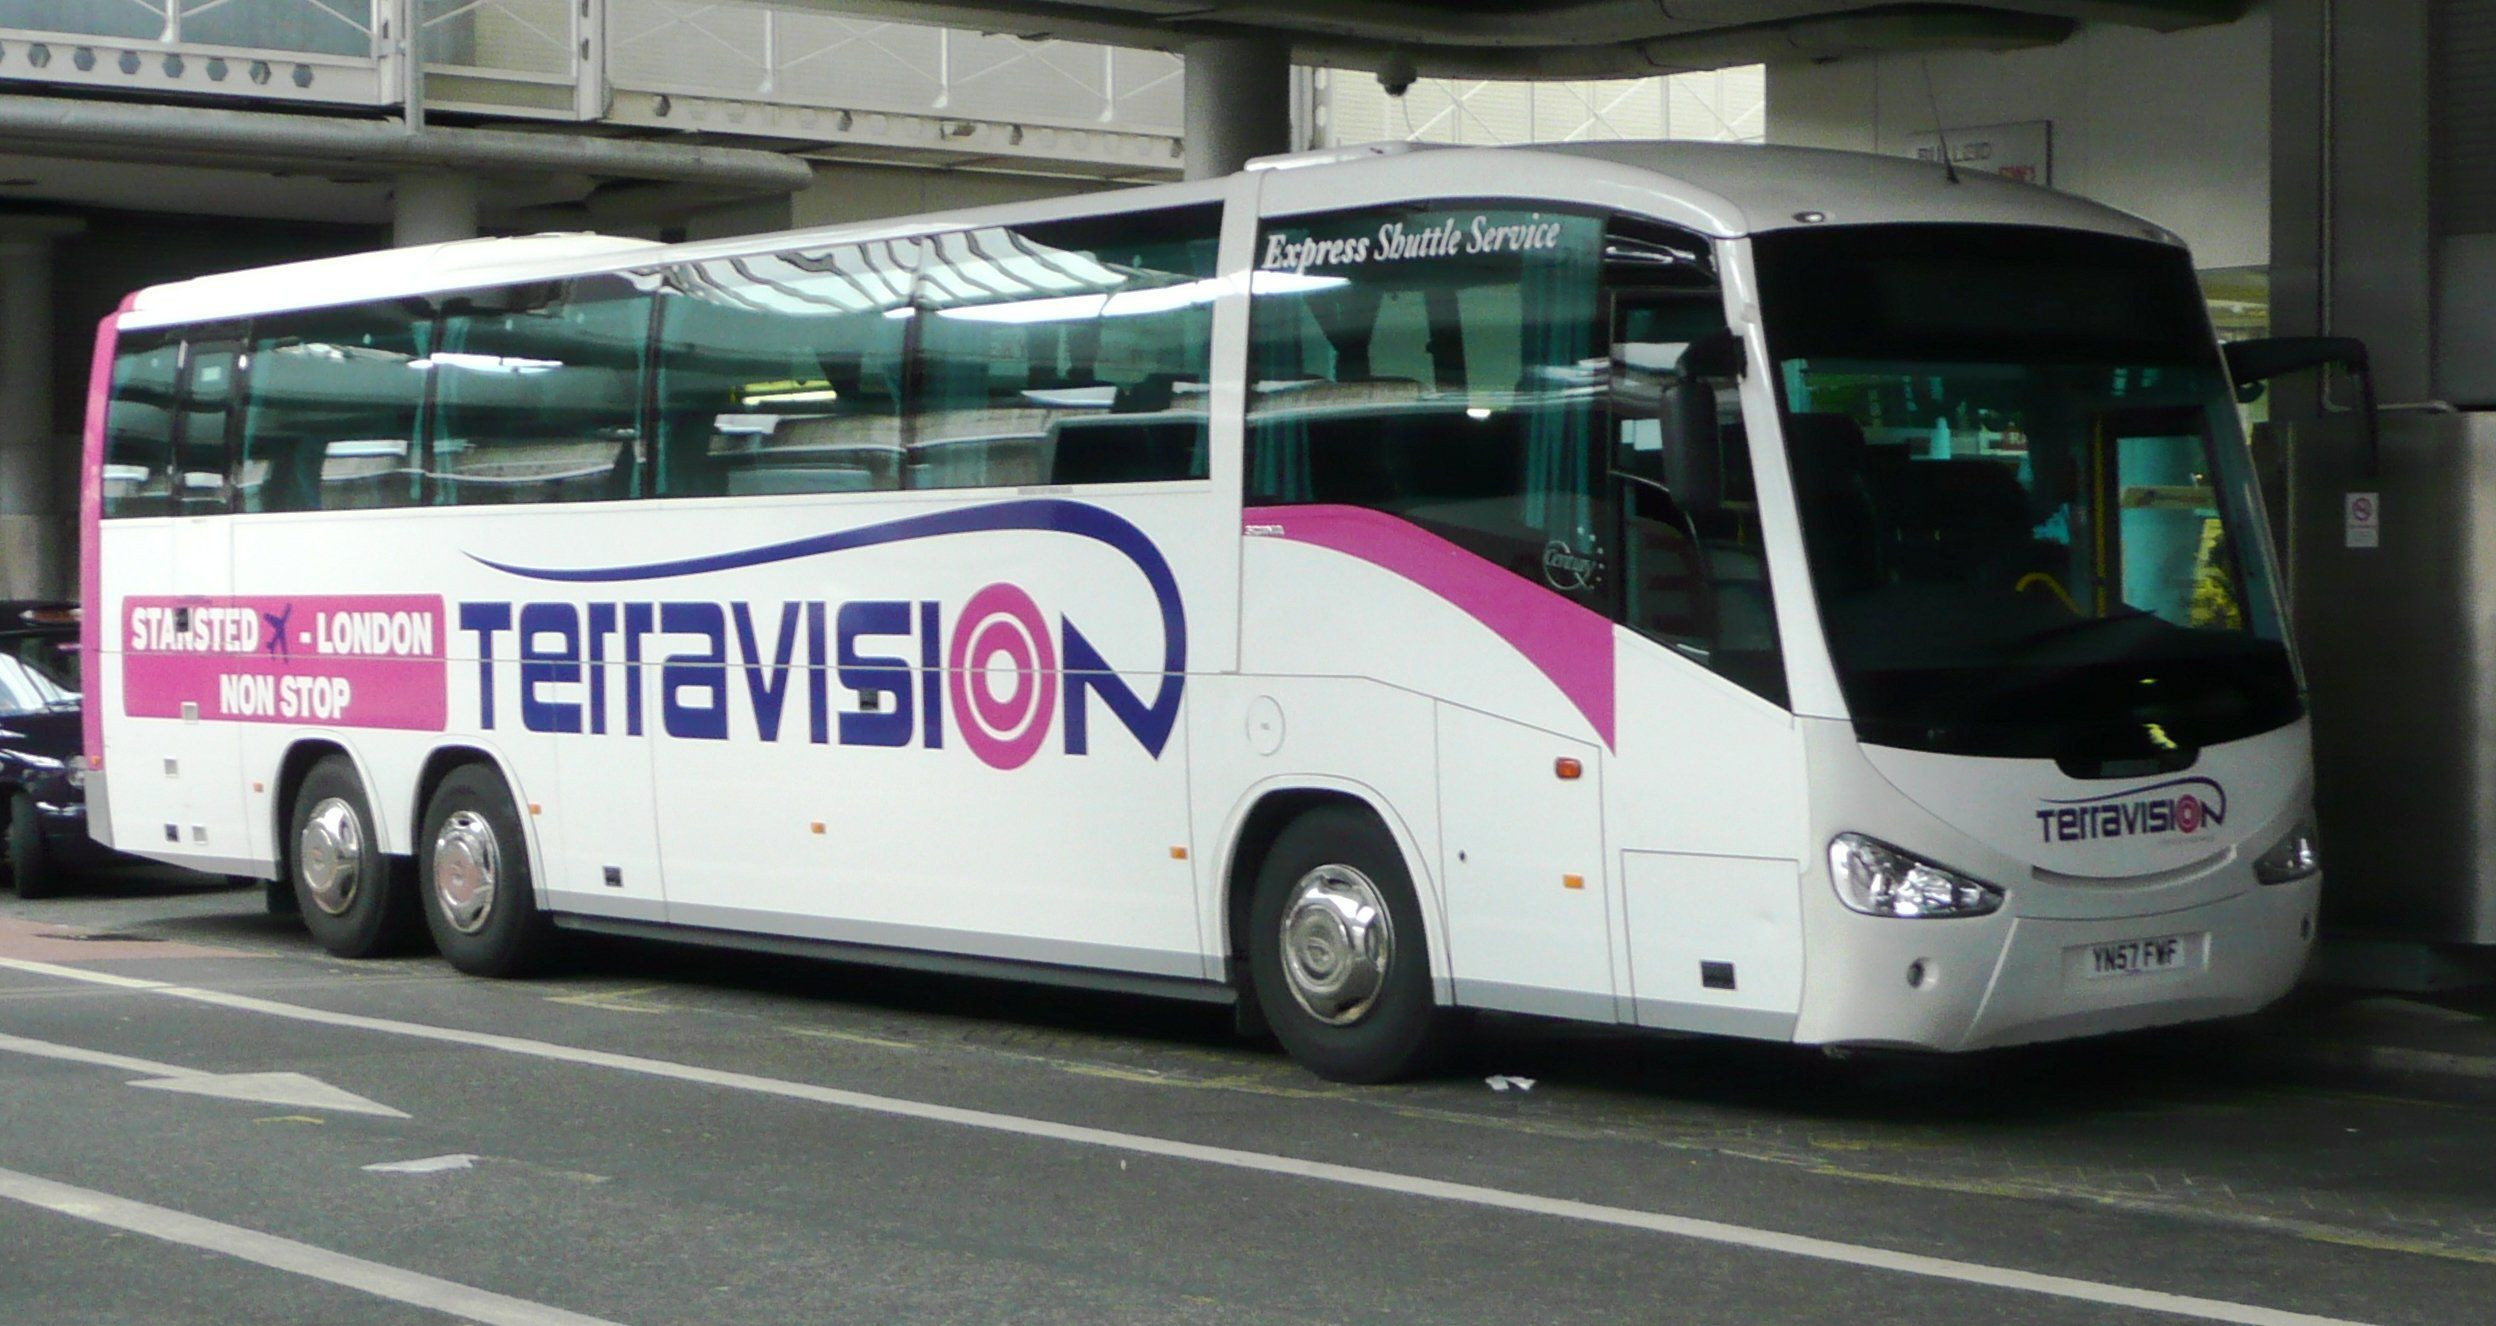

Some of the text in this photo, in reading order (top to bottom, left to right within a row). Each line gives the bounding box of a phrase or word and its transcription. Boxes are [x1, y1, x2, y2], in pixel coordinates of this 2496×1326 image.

[1262, 214, 1560, 276] Express Shuttle Service
[316, 611, 433, 655] LONDON
[219, 673, 351, 719] NON STOP
